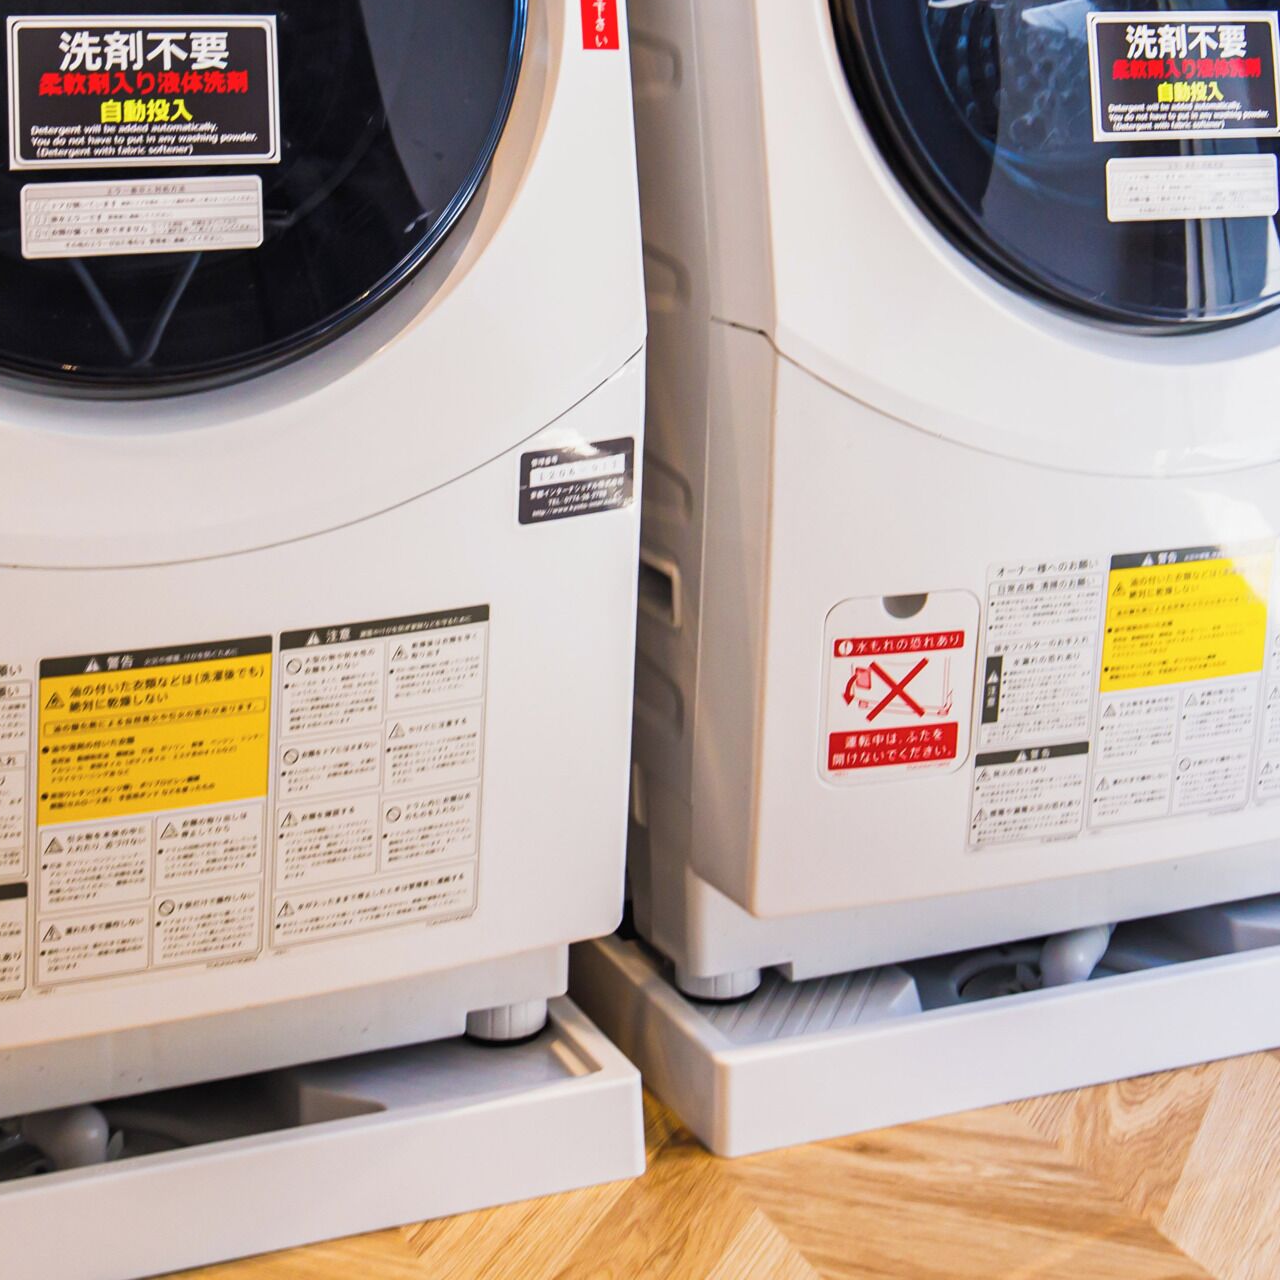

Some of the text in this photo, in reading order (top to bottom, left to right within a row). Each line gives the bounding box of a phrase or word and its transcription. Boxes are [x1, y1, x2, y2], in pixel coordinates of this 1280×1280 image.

[58, 30, 230, 72] 洗剤不要
[1125, 23, 1248, 60] 洗剤不要
[38, 70, 249, 96] 柔軟剤入り液体洗剤
[1157, 81, 1224, 104] 自動投入
[100, 99, 193, 124] 自動投入
[30, 124, 81, 136] Detergent
[83, 123, 101, 135] will
[103, 123, 116, 134] be
[117, 122, 148, 134] added
[30, 136, 51, 147] You
[52, 136, 66, 146] do
[68, 135, 85, 146] not
[87, 135, 112, 146] have
[114, 134, 125, 145] to
[126, 134, 143, 146] put
[177, 133, 219, 144] washing
[93, 145, 116, 157] with
